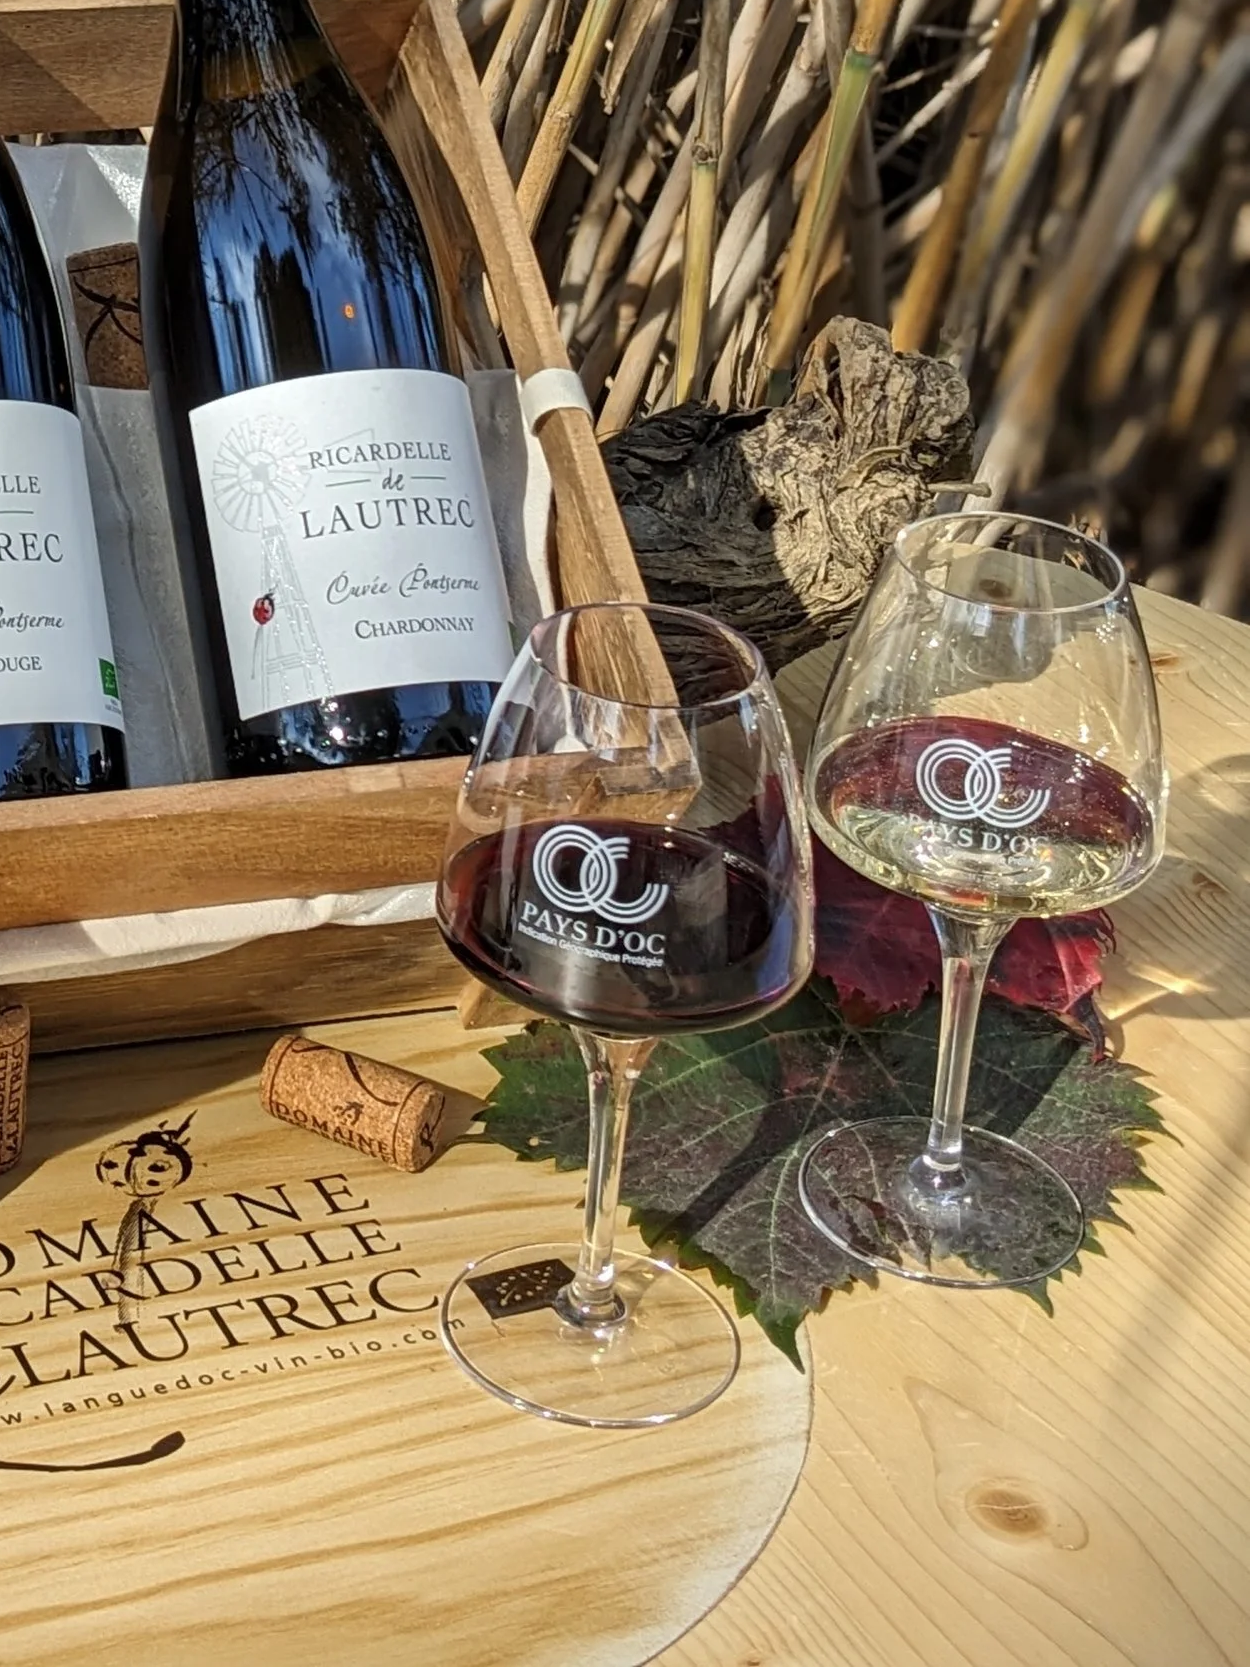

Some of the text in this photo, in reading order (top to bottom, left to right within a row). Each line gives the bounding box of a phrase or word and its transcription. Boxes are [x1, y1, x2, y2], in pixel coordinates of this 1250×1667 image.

[308, 441, 452, 470] RICARDELLE
[381, 467, 405, 492] de
[300, 496, 476, 539] LAUTREC
[326, 570, 392, 605] Cuvée
[353, 616, 475, 640] CHARDONNAY
[517, 922, 558, 947] Indication
[558, 938, 621, 963] Géographique
[520, 900, 666, 956] PAYS D'OC
[275, 1102, 390, 1155] DOMAINE
